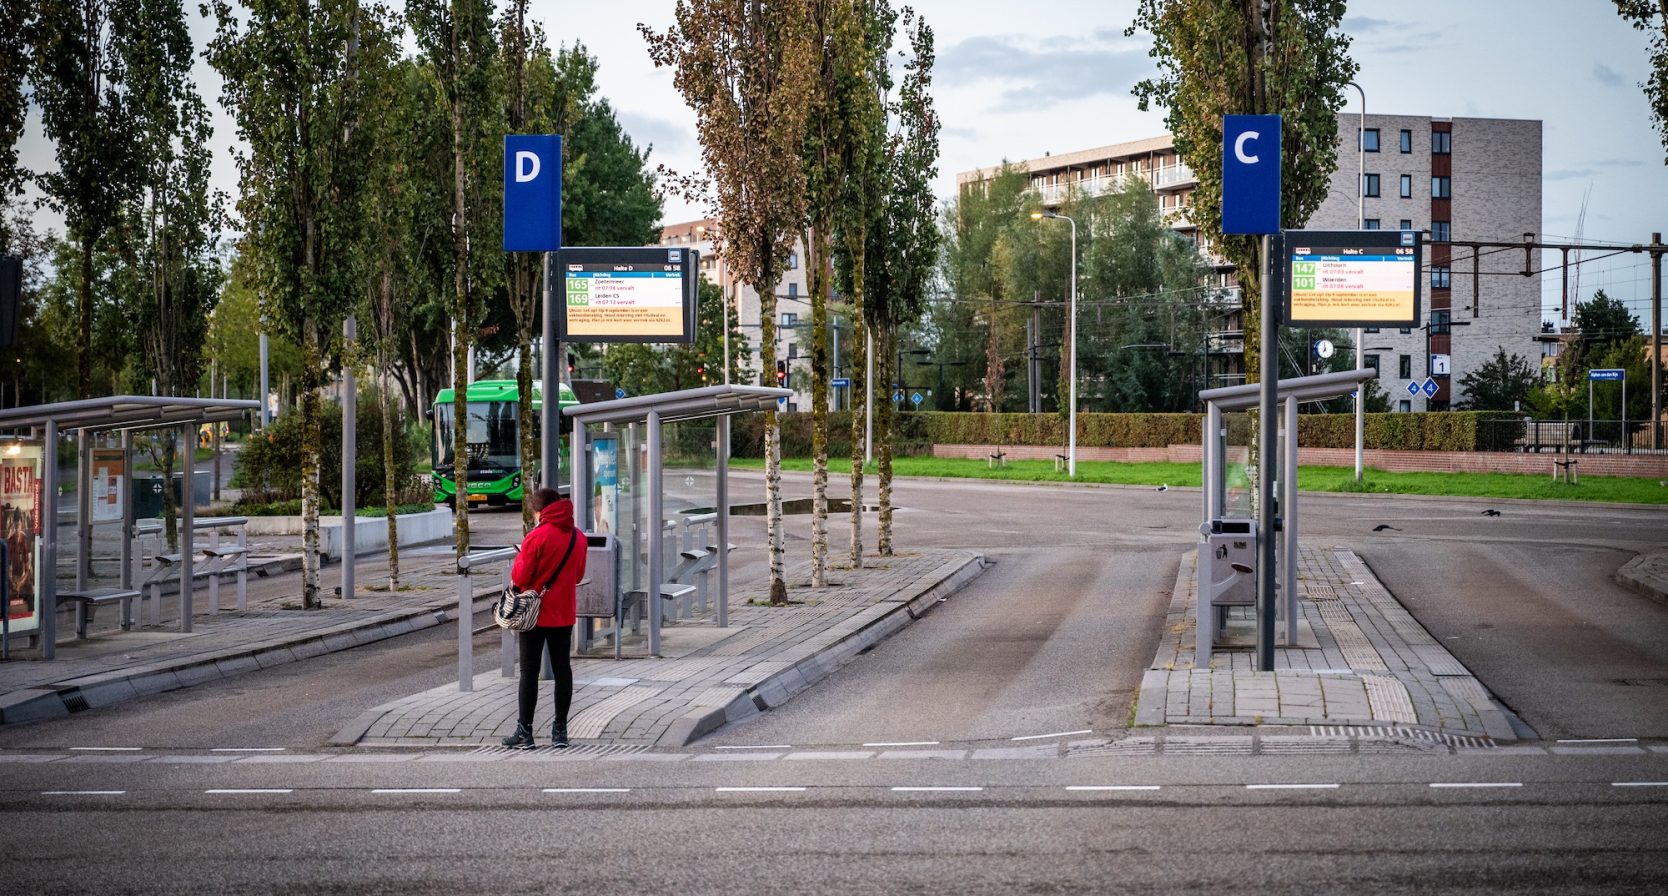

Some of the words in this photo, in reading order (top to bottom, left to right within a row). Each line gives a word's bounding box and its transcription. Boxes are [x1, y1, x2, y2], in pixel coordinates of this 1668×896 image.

[1235, 131, 1259, 164] C
[516, 151, 540, 182] D
[1295, 263, 1314, 273] 147
[569, 280, 588, 290] 165
[1295, 278, 1314, 288] 101
[569, 294, 588, 304] 169
[1440, 362, 1444, 373] 1
[1426, 383, 1434, 393] 4
